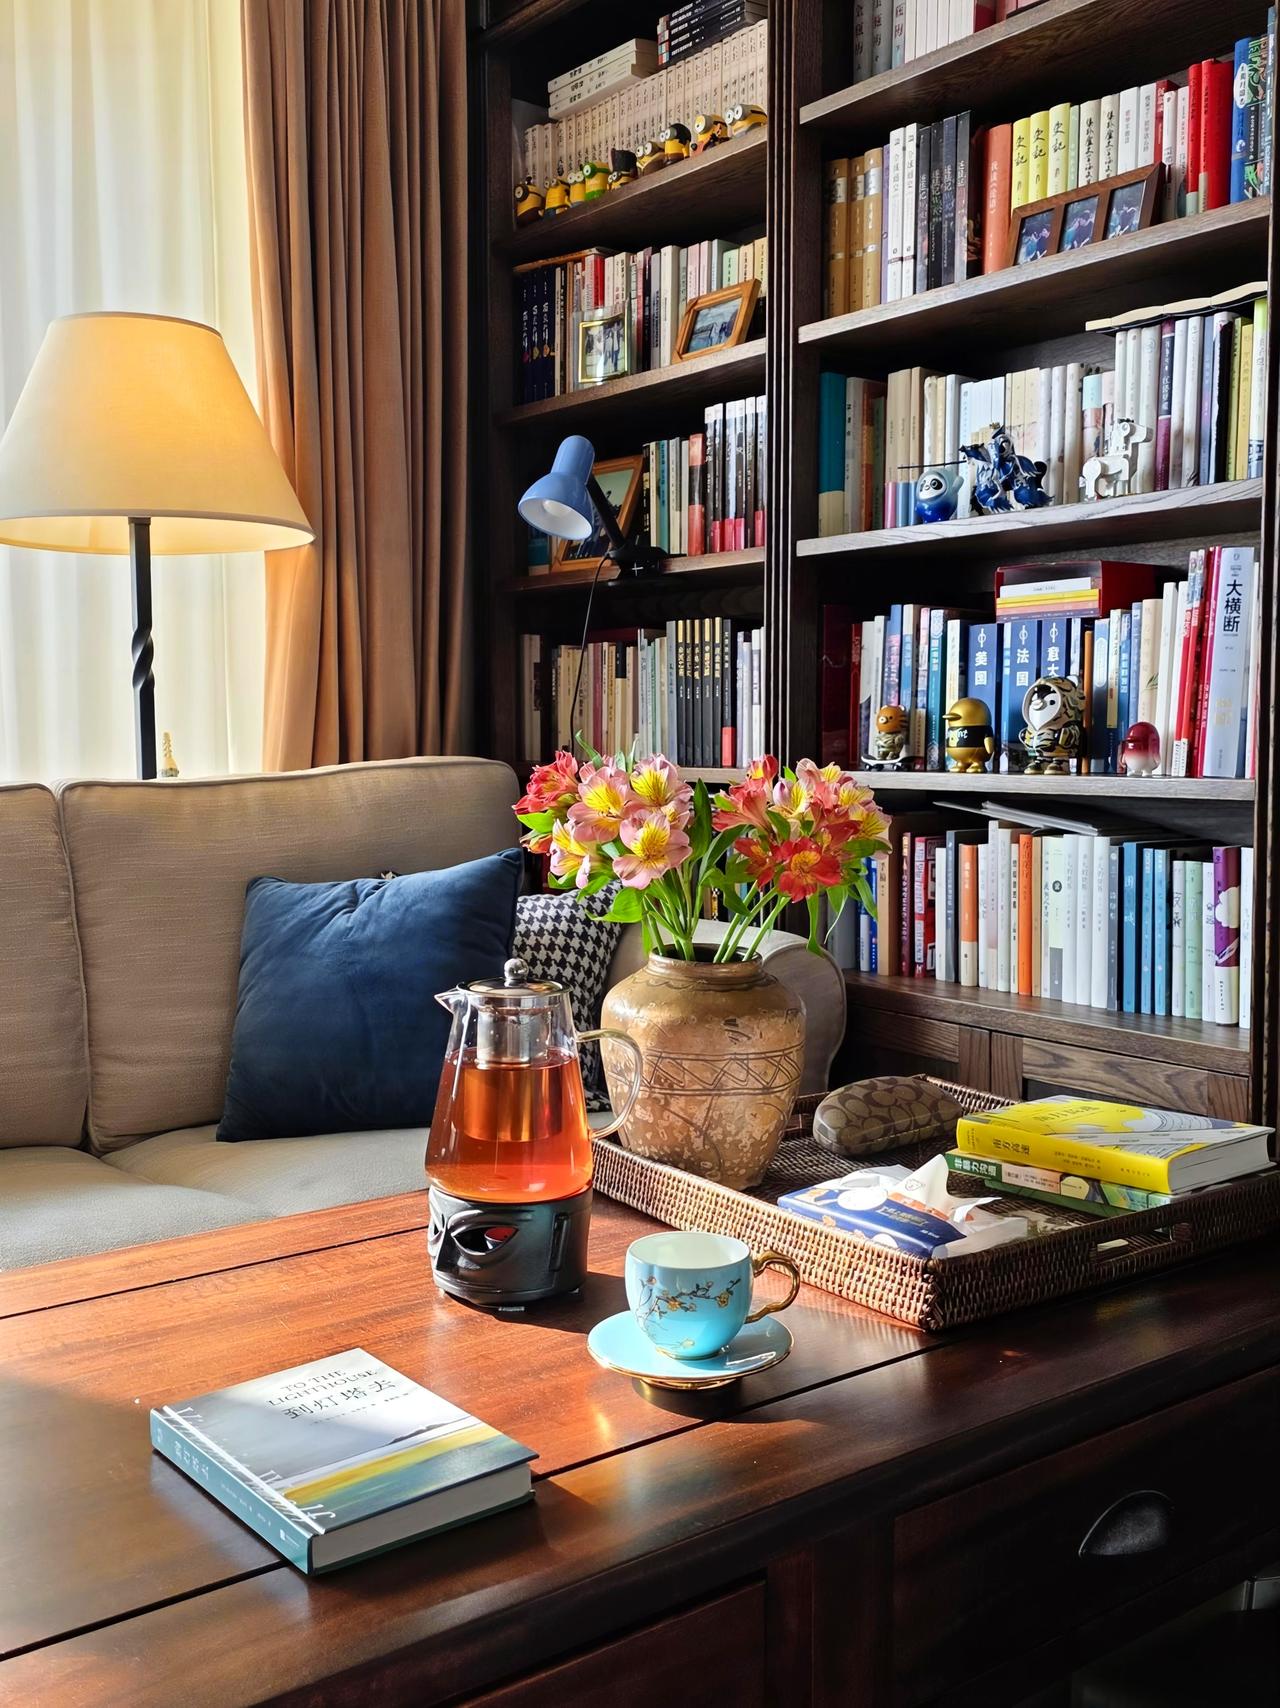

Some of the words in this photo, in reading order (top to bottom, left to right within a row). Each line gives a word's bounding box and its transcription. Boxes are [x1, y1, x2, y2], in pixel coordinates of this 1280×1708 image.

[1223, 579, 1243, 632] 大横断
[974, 650, 988, 686] 美国
[1016, 647, 1030, 687] 法国
[992, 1138, 1030, 1156] 南方高速
[954, 1156, 997, 1177] 非暴力沟通
[267, 1369, 378, 1407] LIGHTHOUSE
[280, 1380, 307, 1392] TO
[308, 1368, 347, 1384] THE
[281, 1379, 396, 1420] 到灯塔去
